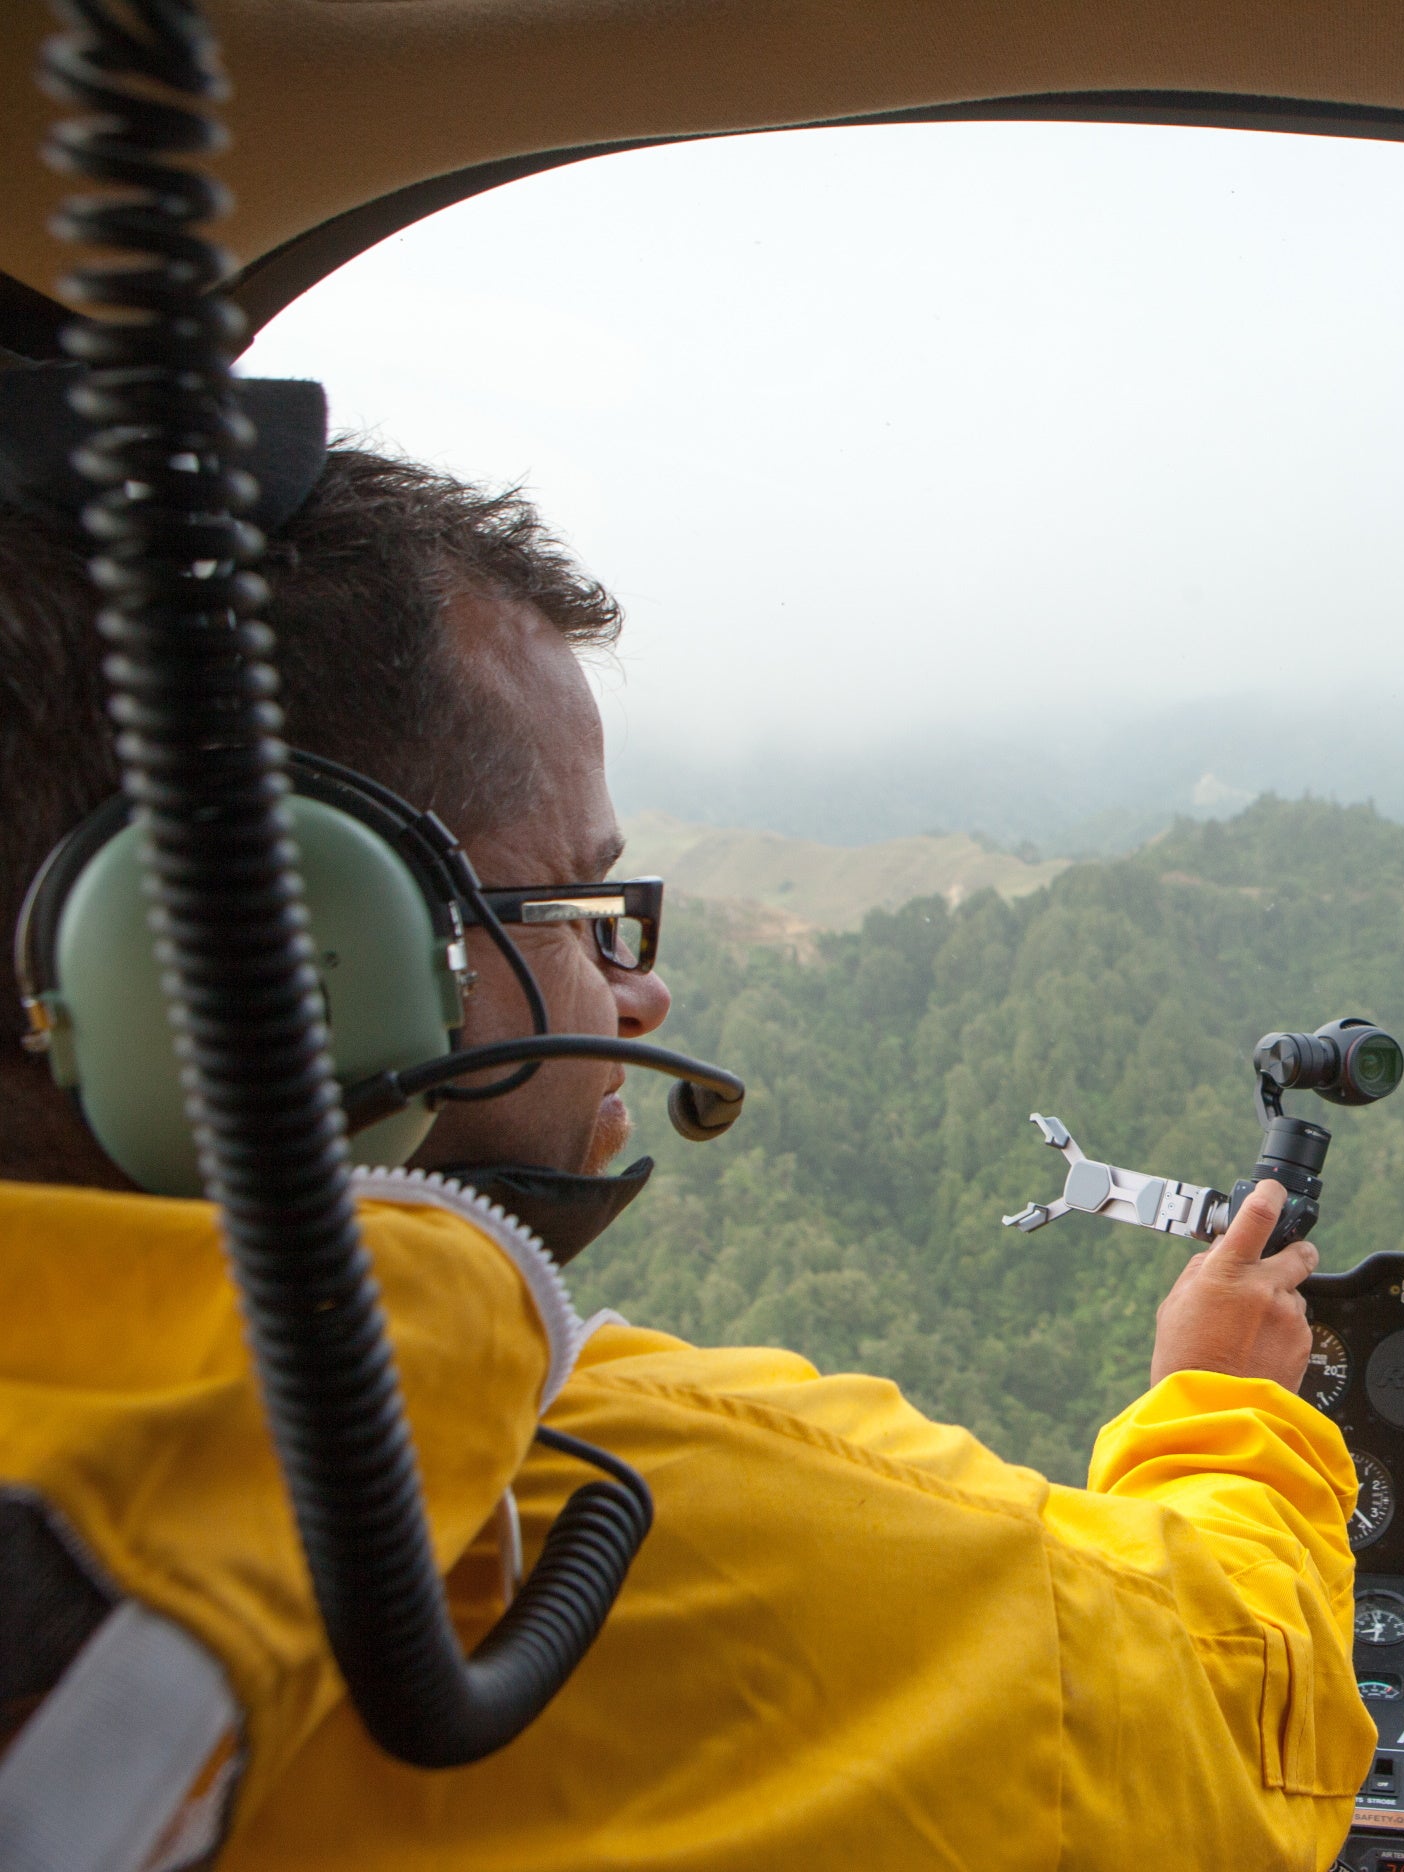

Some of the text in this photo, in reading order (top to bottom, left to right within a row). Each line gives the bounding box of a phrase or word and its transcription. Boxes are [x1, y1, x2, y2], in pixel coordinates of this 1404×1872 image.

[1324, 1365, 1337, 1376] 20
[1372, 1480, 1380, 1490] 2
[1370, 1508, 1378, 1518] 3
[1367, 1797, 1397, 1806] STROBE
